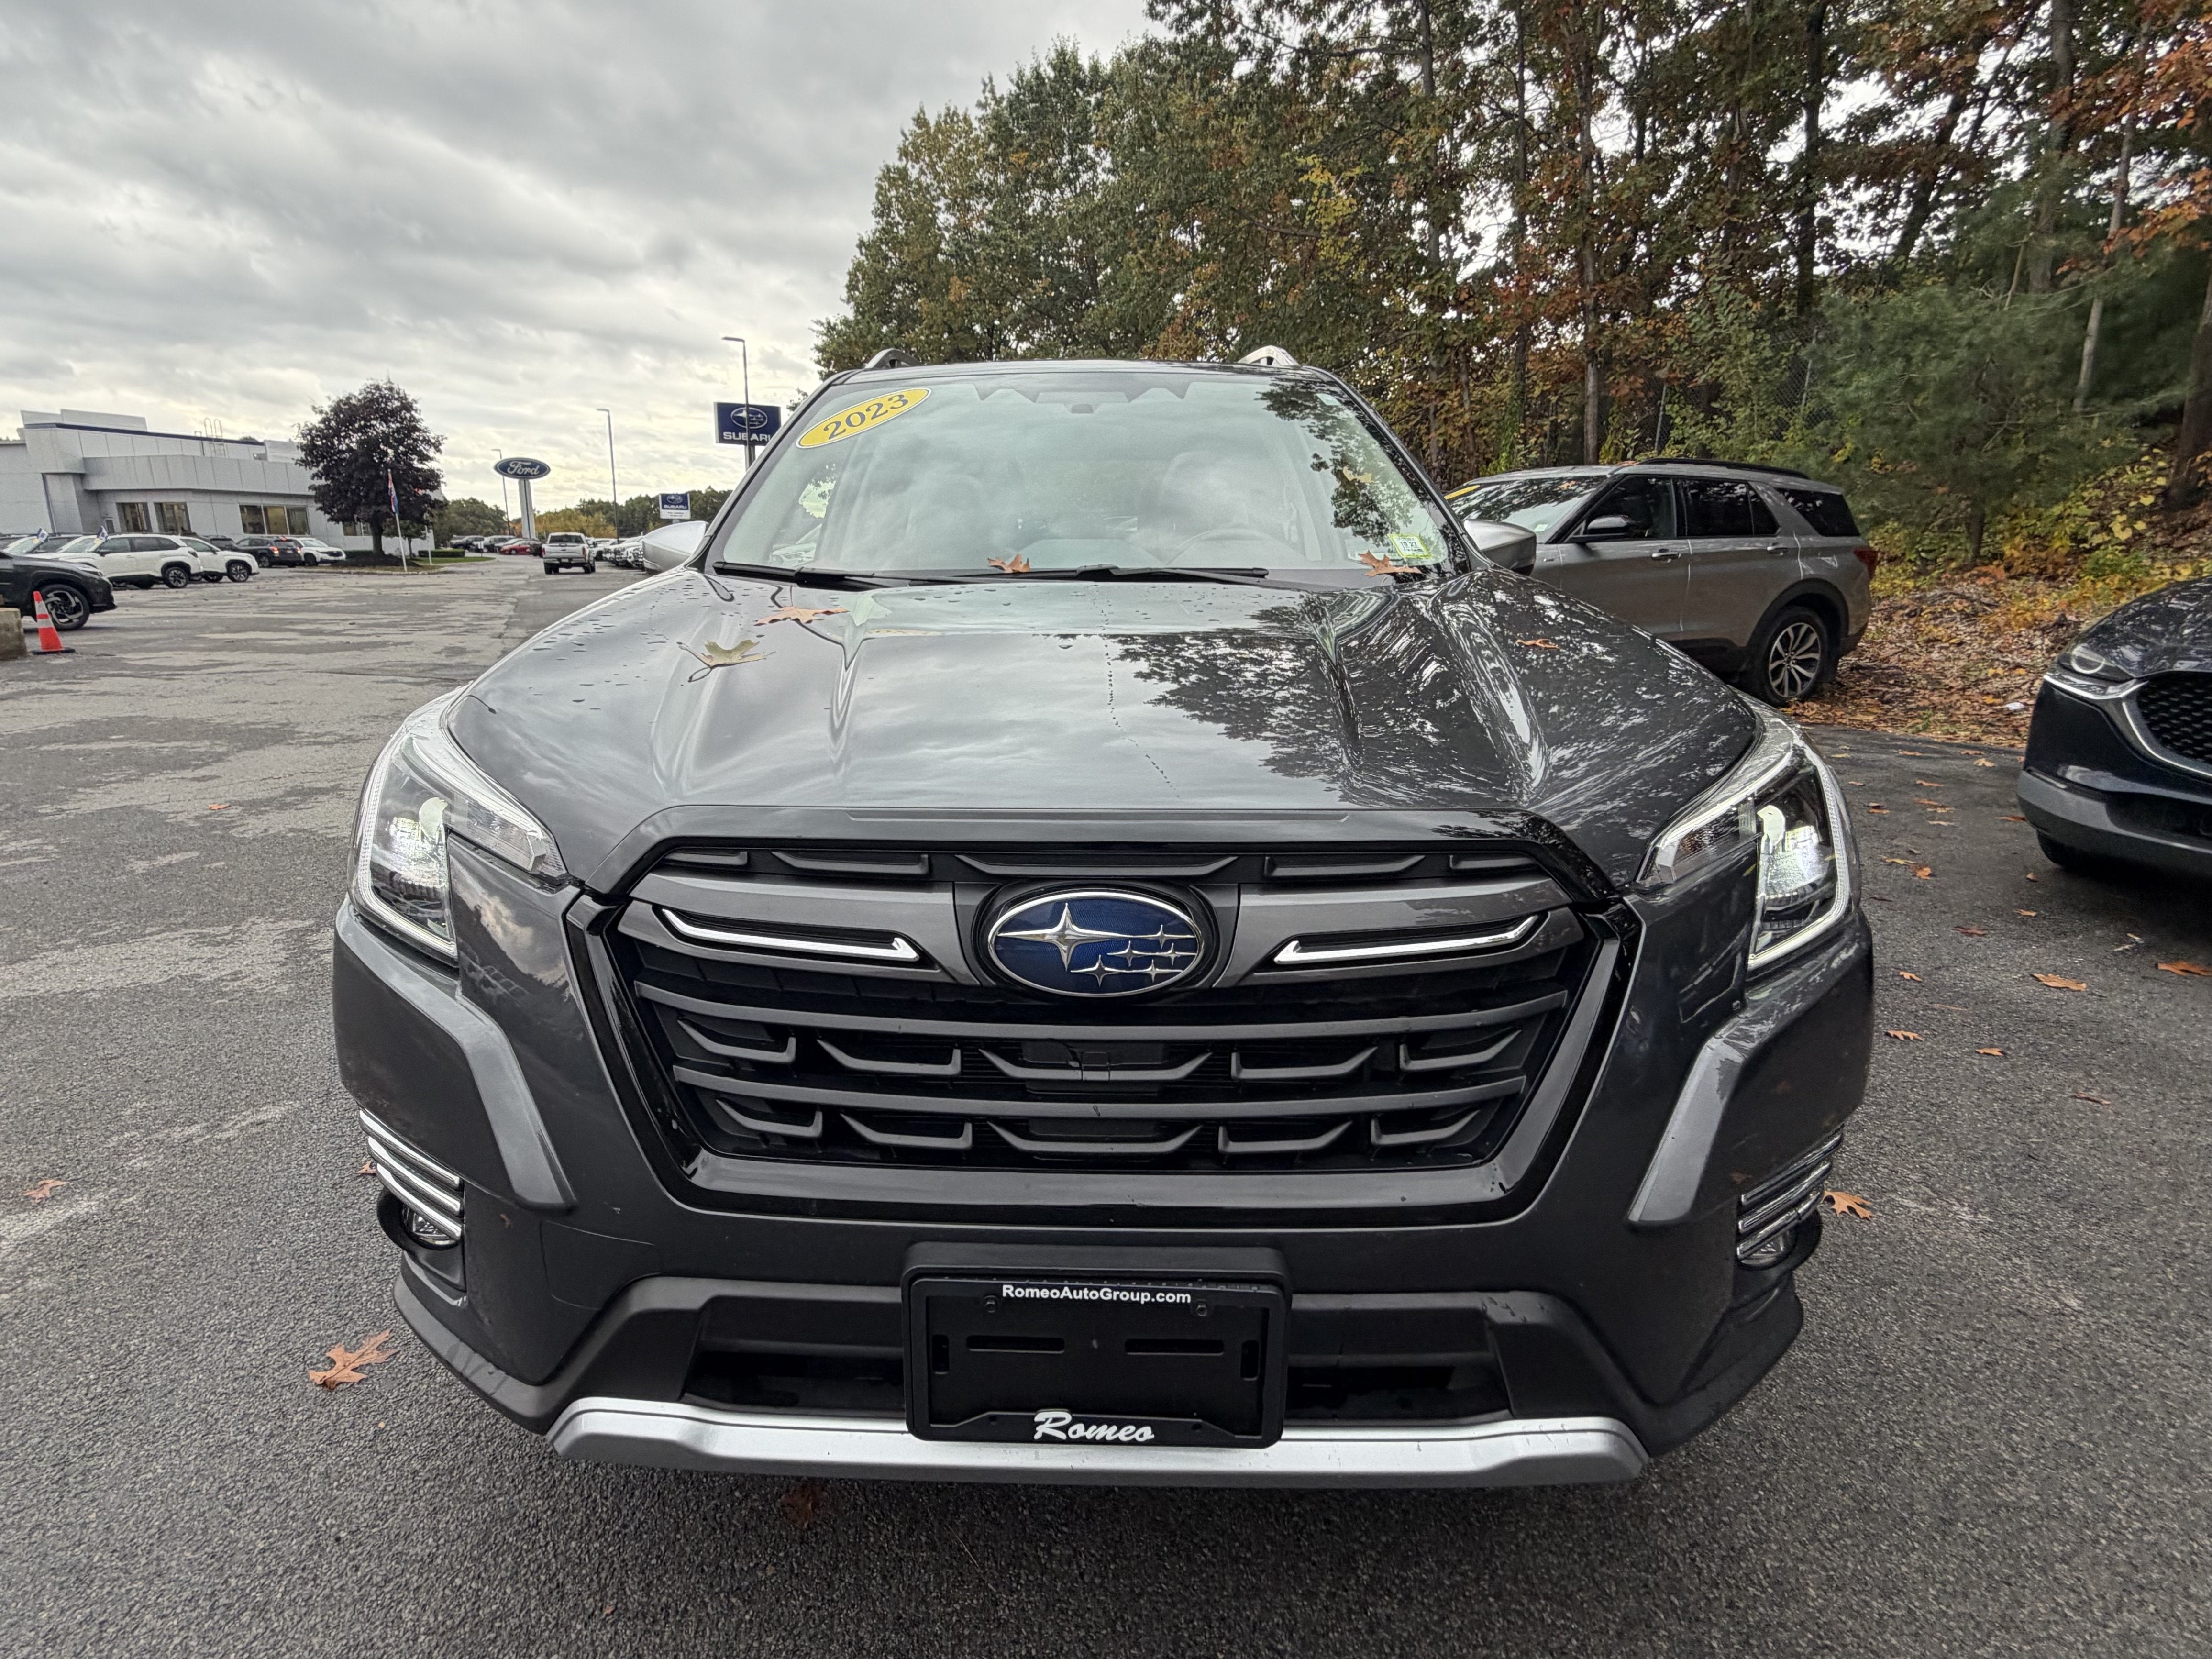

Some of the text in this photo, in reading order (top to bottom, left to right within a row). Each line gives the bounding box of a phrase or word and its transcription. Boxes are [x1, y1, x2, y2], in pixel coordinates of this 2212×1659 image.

[823, 394, 909, 440] 2023
[723, 431, 773, 442] SUBAR
[507, 461, 540, 475] Ford
[1002, 1284, 1191, 1305] RomeoAutoGroup.com
[1033, 1411, 1155, 1442] Romeo
